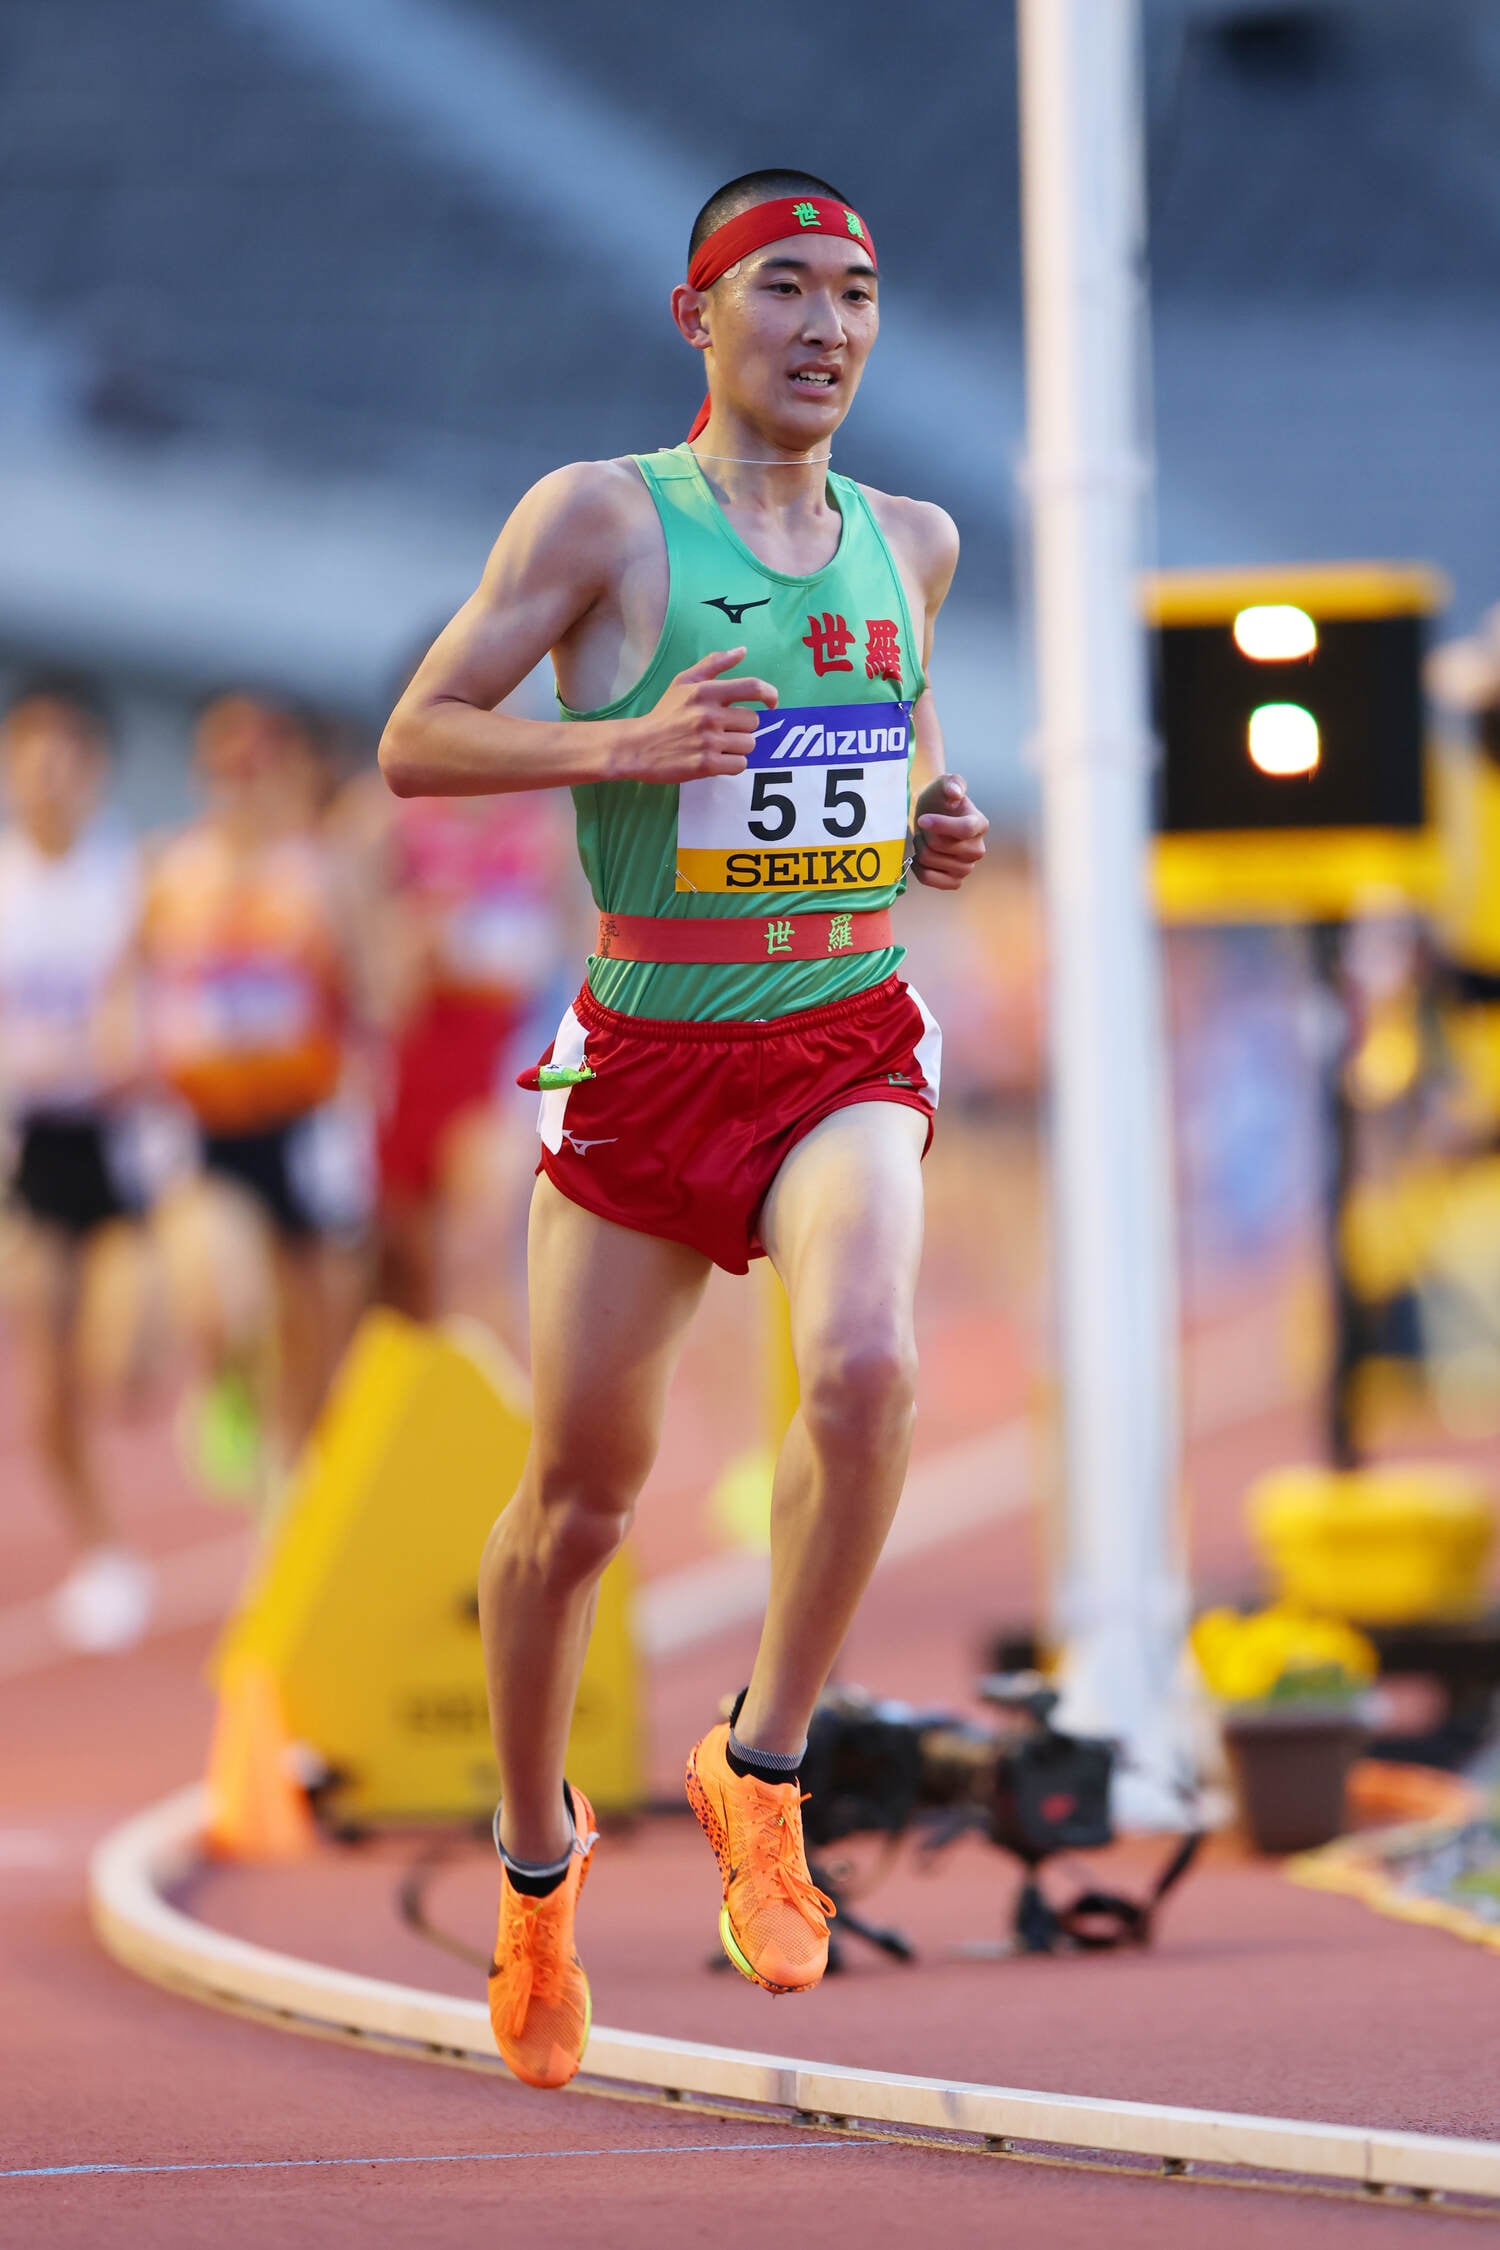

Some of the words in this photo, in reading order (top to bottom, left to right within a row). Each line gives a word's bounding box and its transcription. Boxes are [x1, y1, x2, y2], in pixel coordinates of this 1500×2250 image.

[802, 612, 903, 682] 世羅
[726, 847, 881, 887] SEIKO
[763, 913, 854, 955] 世羅
